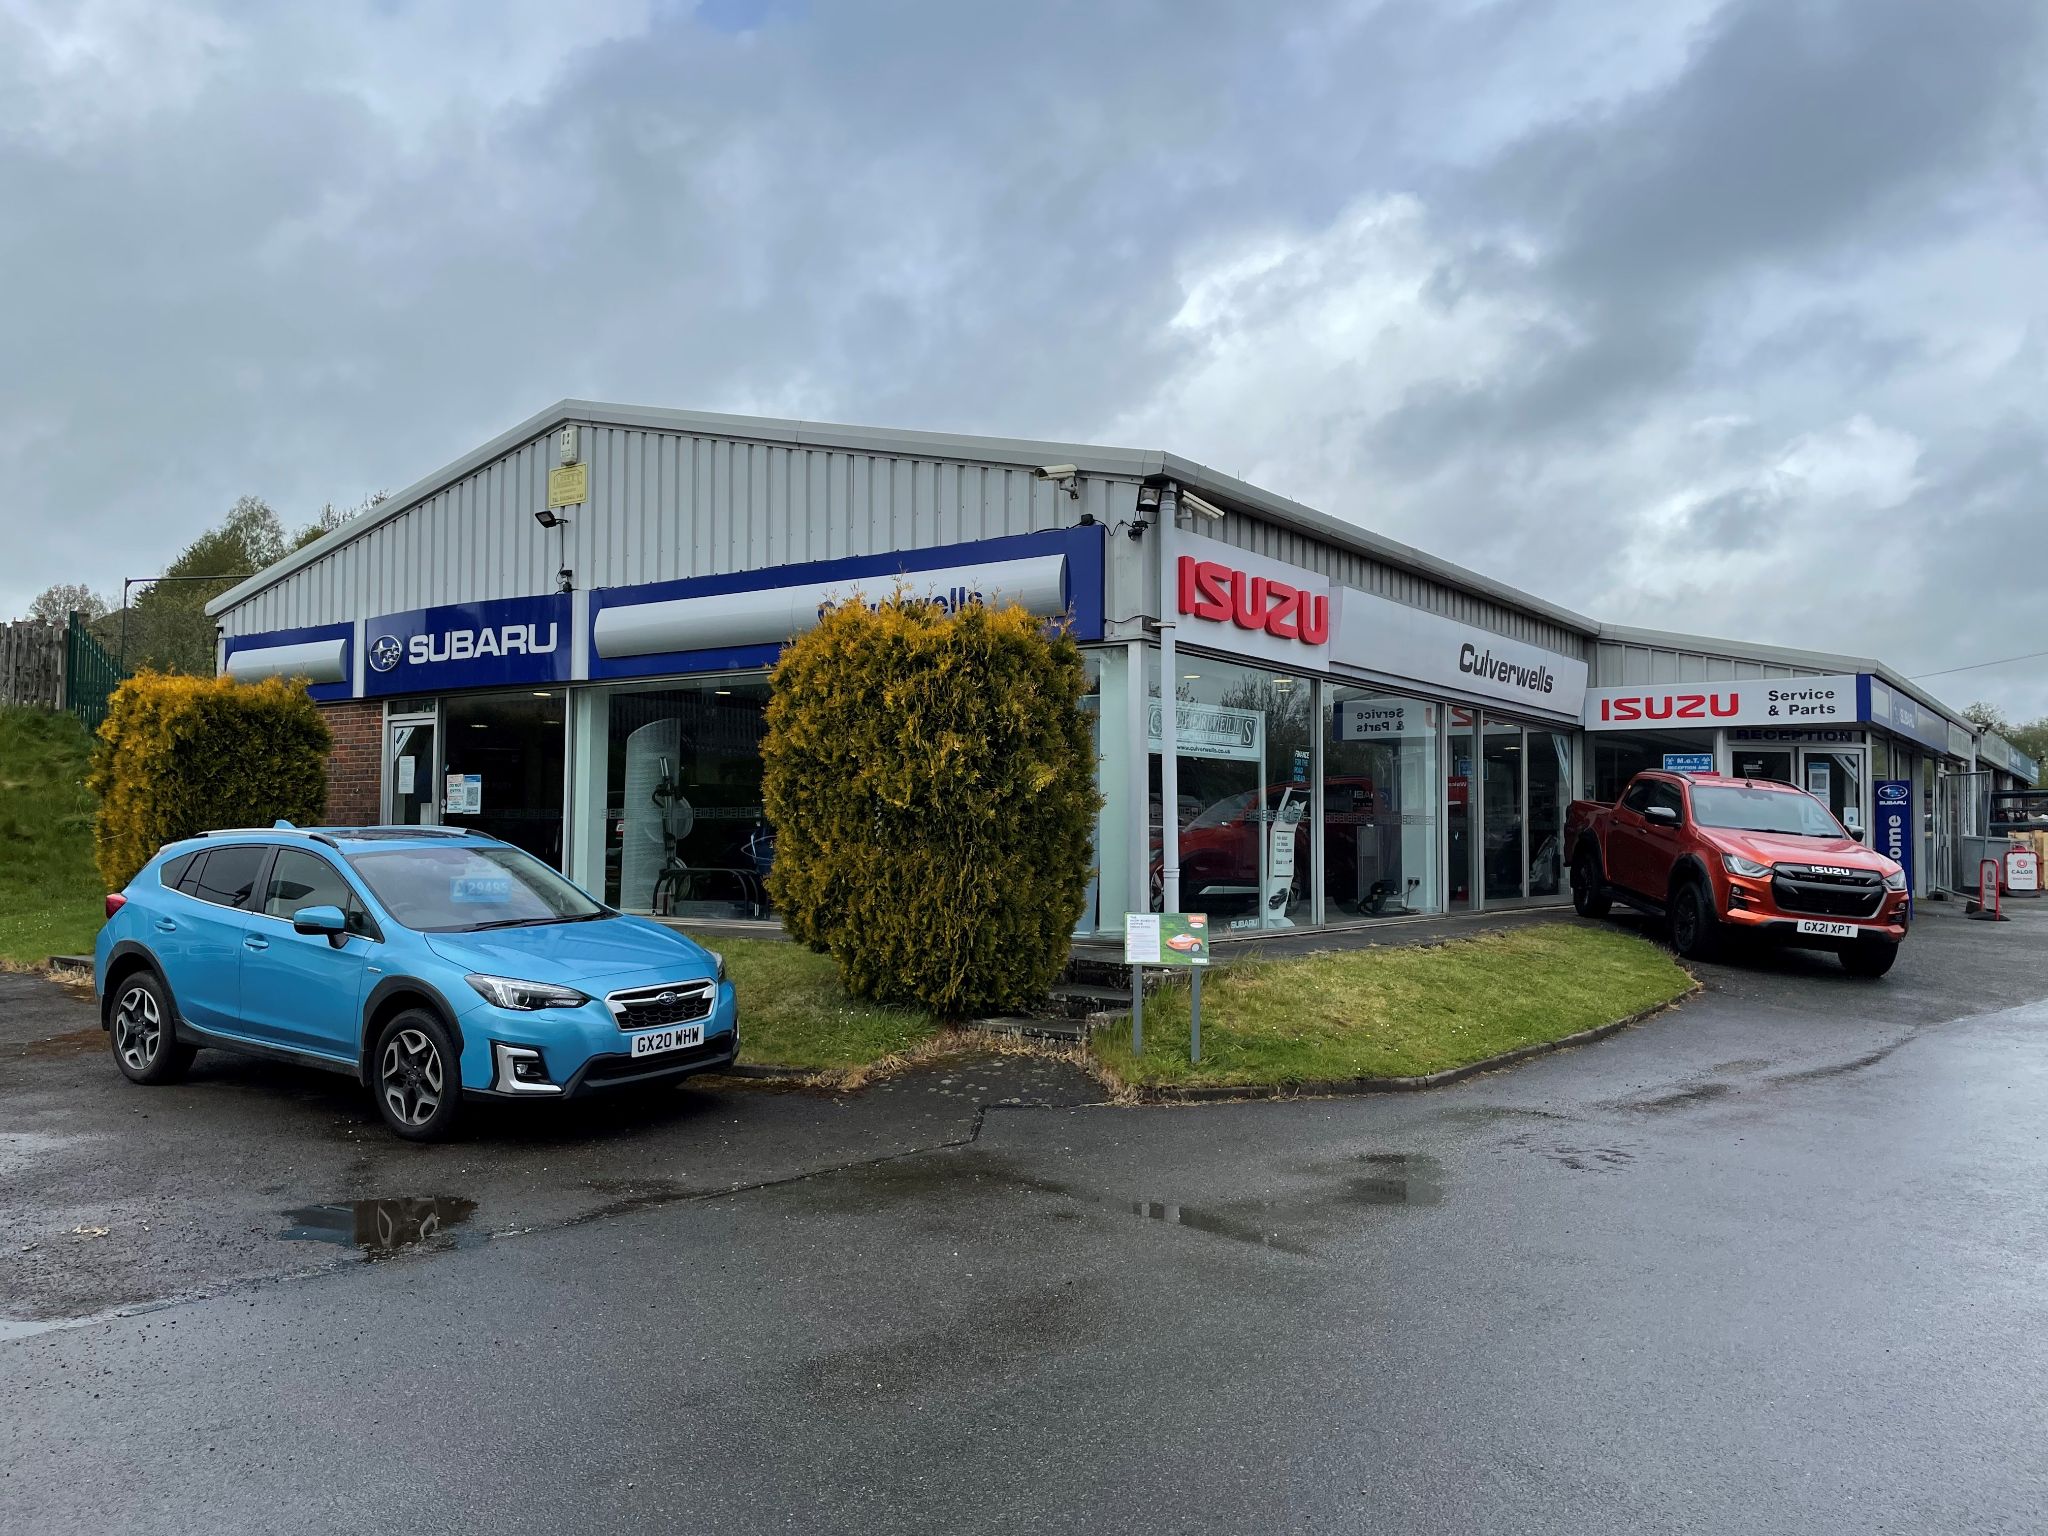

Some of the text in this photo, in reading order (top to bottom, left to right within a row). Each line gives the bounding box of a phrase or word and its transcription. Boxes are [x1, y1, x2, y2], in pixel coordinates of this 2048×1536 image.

[1177, 555, 1329, 645] ISUZU
[408, 622, 558, 665] SUBARU
[1459, 643, 1554, 693] Culverwells
[1768, 688, 1835, 702] Service
[1601, 693, 1739, 721] ISUZU
[1768, 703, 1836, 716] & Parts
[1736, 729, 1853, 742] RECEPTION
[1811, 865, 1850, 876] ISUZU
[1804, 921, 1852, 935] GX21 XPT
[637, 1026, 700, 1053] GX20 WHW
